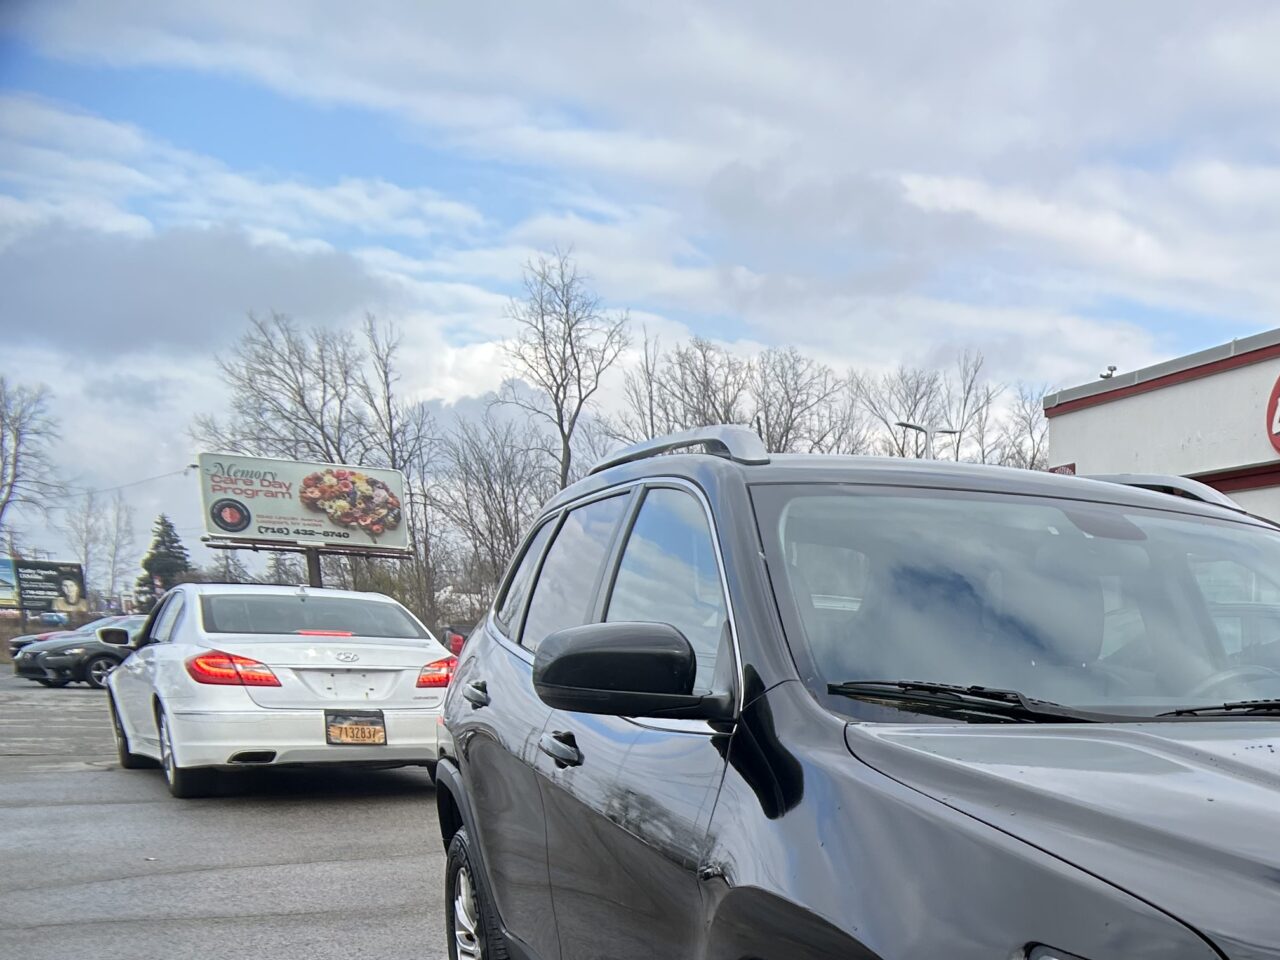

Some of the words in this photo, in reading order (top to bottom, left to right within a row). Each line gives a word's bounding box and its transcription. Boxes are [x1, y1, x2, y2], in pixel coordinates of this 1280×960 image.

[205, 462, 278, 481] Memory
[211, 474, 254, 486] Care
[260, 479, 293, 492] Day
[211, 484, 293, 499] Program
